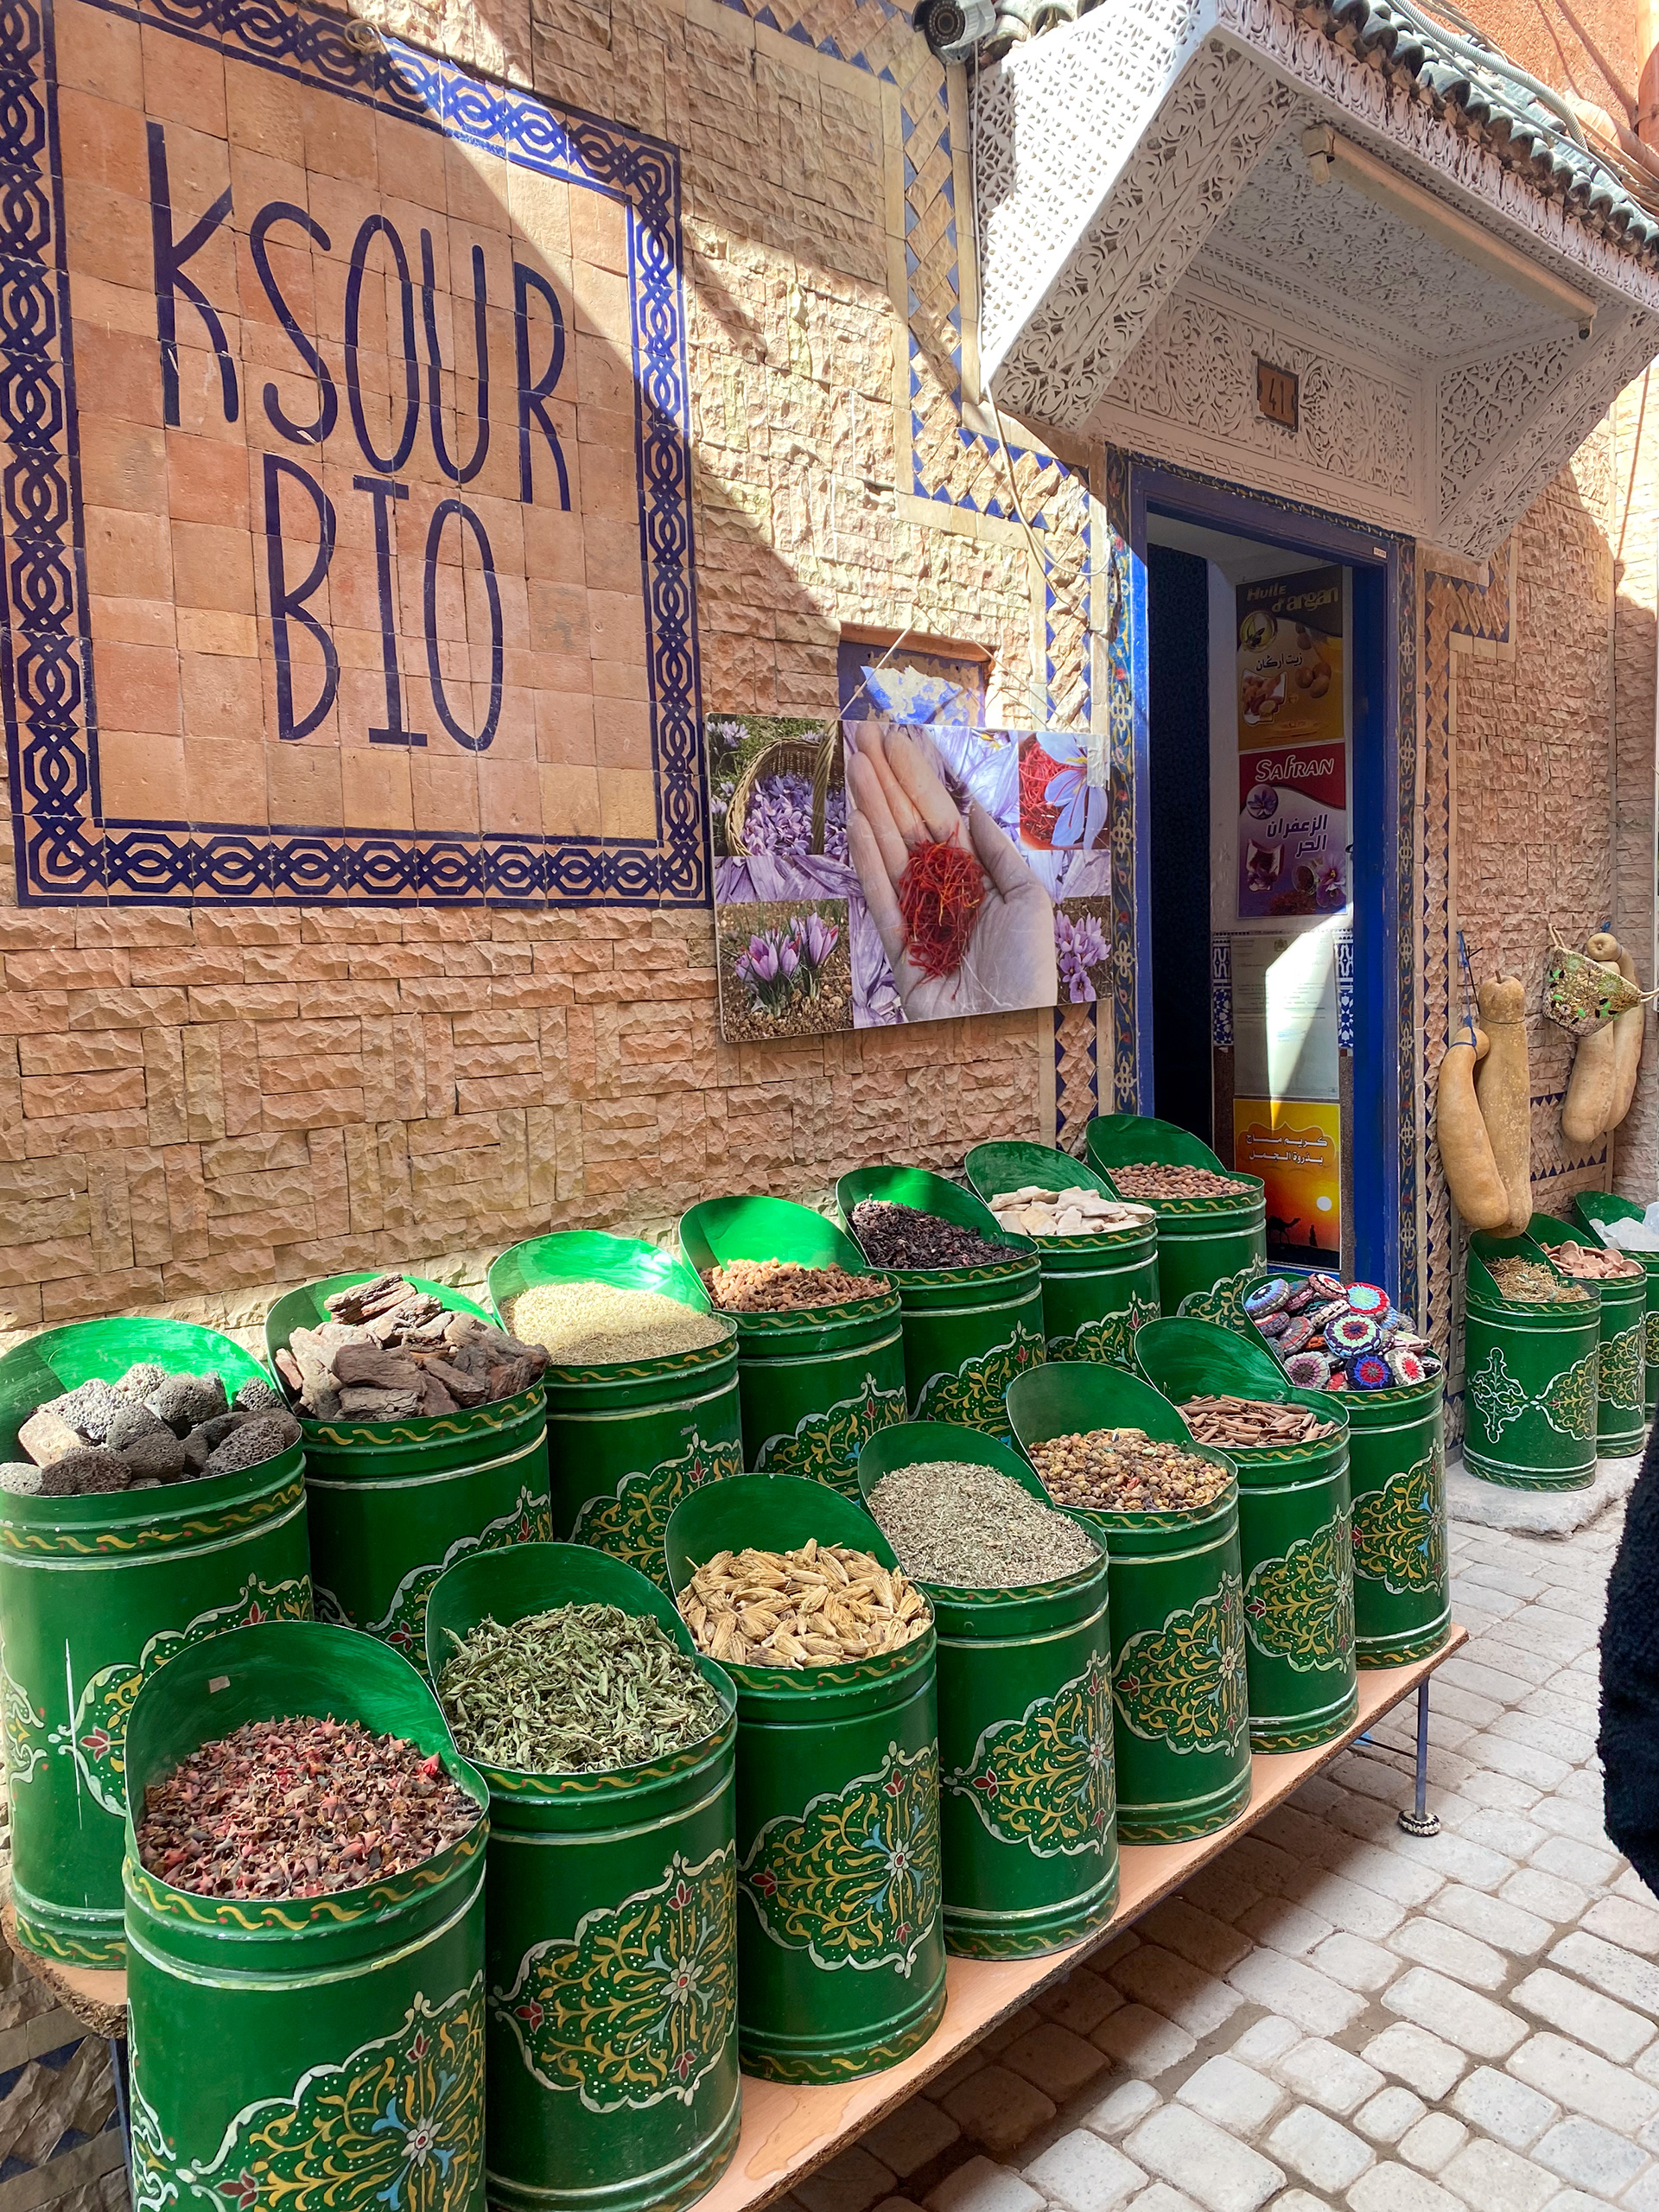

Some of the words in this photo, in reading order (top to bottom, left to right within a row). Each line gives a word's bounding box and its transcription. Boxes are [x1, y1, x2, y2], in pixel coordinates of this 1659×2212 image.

[146, 122, 572, 512] KSOUR
[1268, 378, 1285, 415] 41
[262, 454, 504, 752] BIO
[1286, 652, 1303, 667] زيت
[1267, 814, 1328, 839] الزعفران
[1296, 835, 1327, 858] الحر
[1283, 1136, 1328, 1148] كريم
[1249, 1148, 1292, 1162] الجمل
[1293, 1151, 1324, 1166] بذروة
